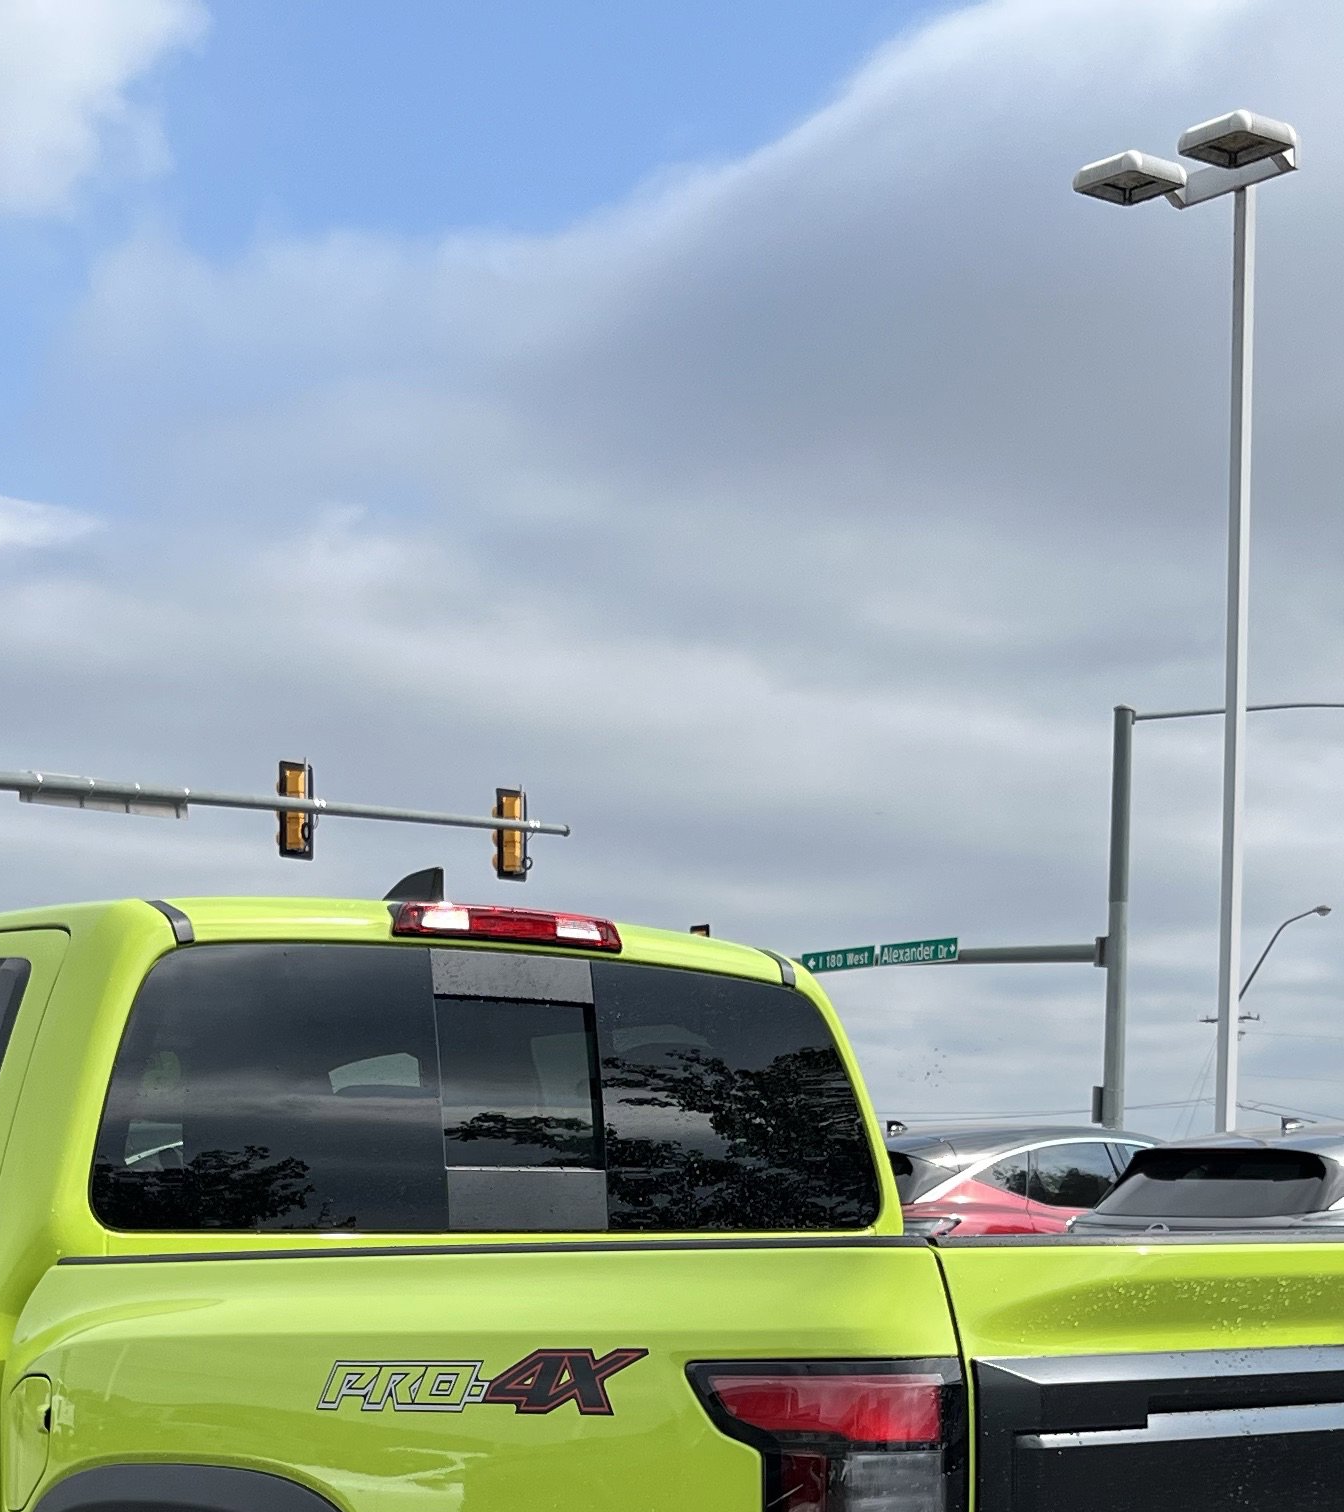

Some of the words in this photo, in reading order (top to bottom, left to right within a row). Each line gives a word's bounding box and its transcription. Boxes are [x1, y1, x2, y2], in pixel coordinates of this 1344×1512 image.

[826, 953, 843, 968] 180
[846, 951, 869, 965] West
[881, 943, 935, 964] Alexander
[938, 944, 948, 959] Dr
